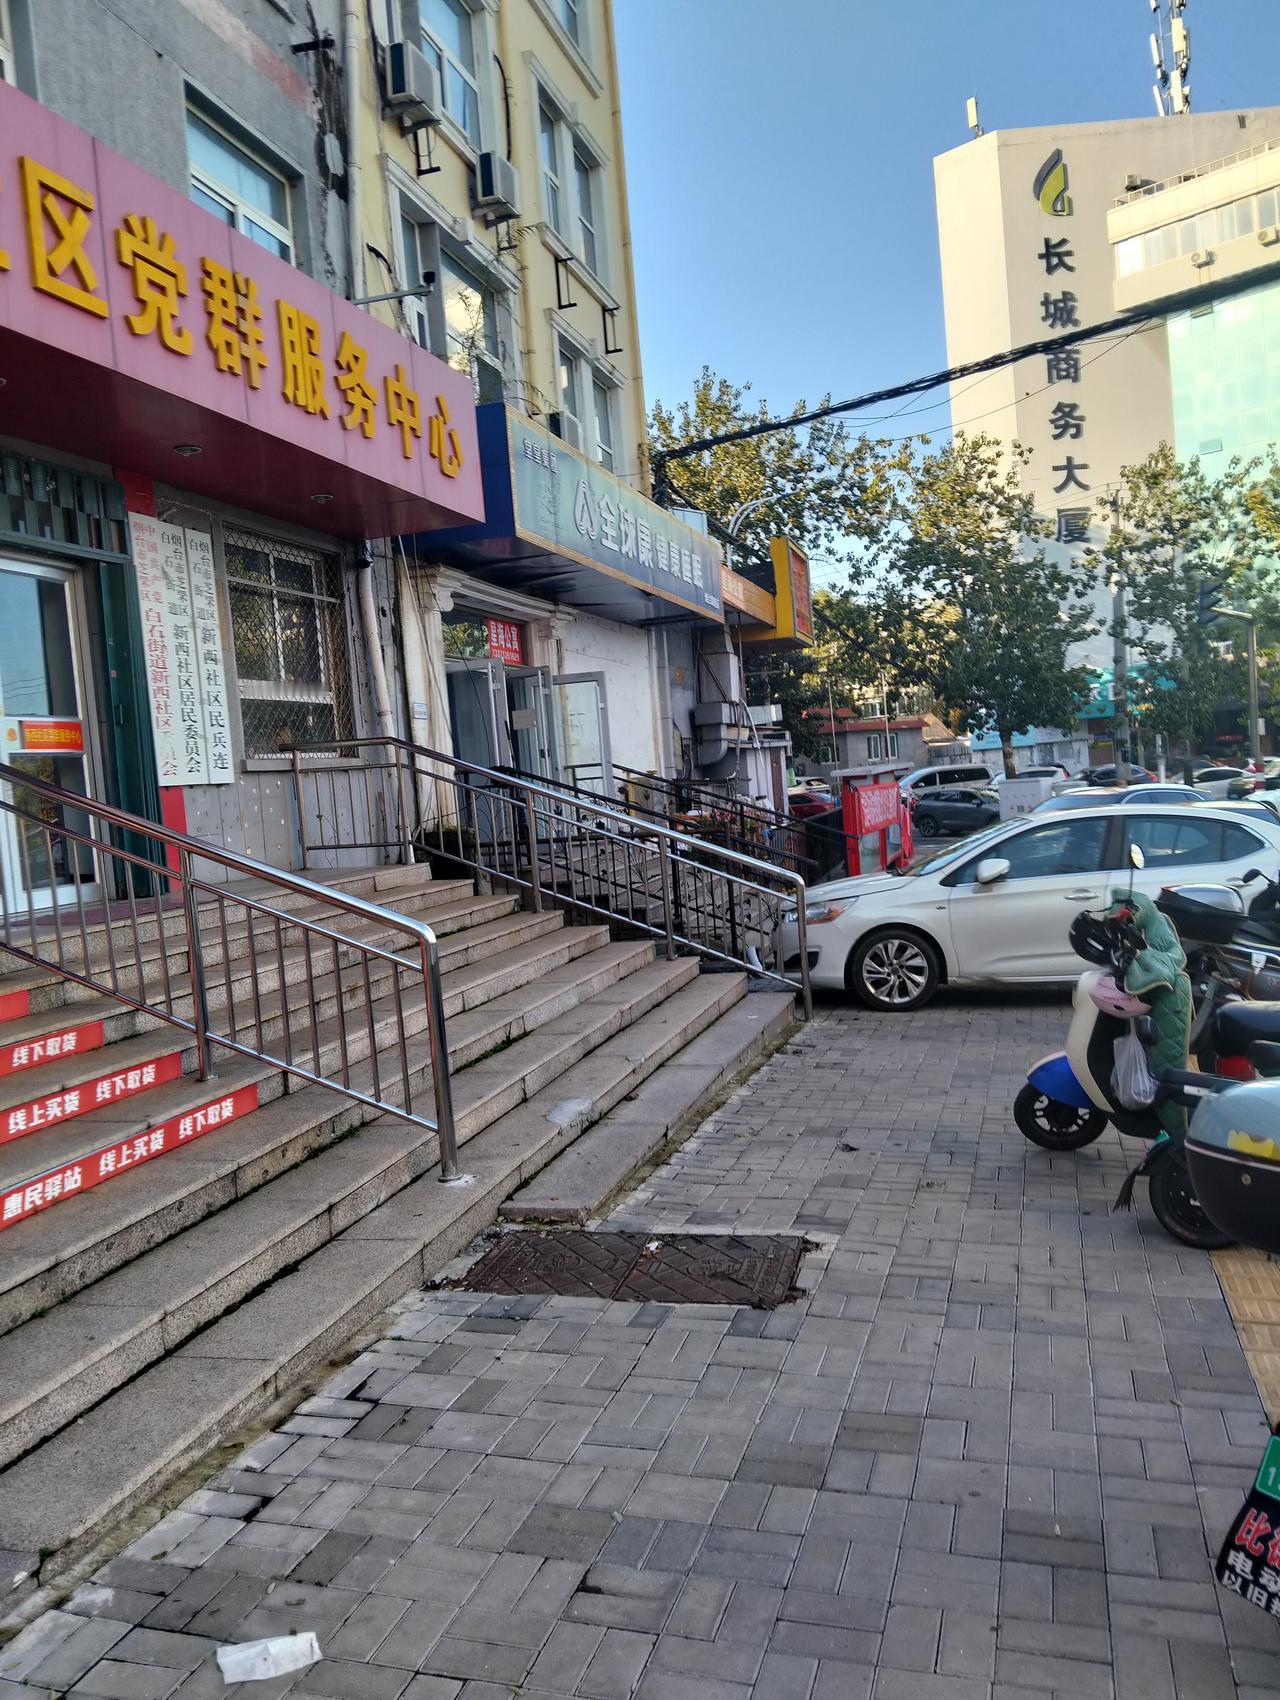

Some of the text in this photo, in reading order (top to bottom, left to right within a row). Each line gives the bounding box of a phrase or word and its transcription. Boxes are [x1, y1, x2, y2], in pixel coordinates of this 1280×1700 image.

[0, 155, 464, 479] 区党群服务中心
[1038, 236, 1091, 546] 长城商务大厦
[145, 608, 178, 776] 白石街道新西社区会
[173, 624, 201, 773] 新西社区居民委员会
[201, 627, 229, 770] 新西社区民兵连
[8, 1064, 156, 1134] 线上买货 线下取货
[11, 1031, 78, 1067] 线下取货
[2, 1098, 235, 1221] 惠民驿站 线上买货 线下取货
